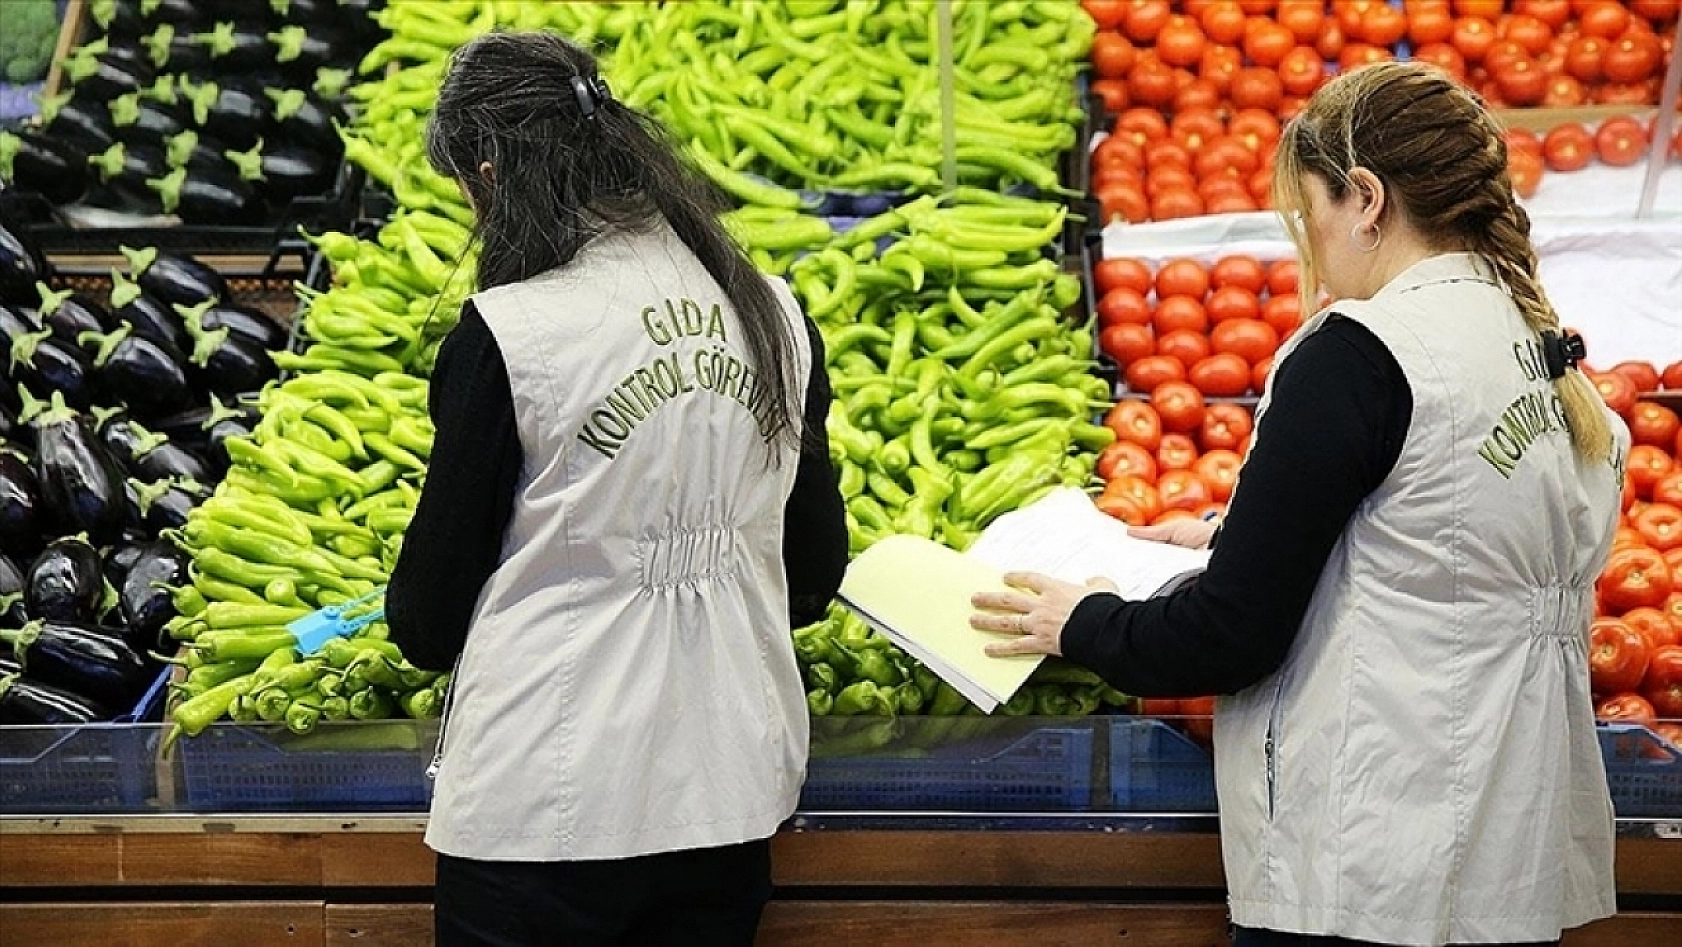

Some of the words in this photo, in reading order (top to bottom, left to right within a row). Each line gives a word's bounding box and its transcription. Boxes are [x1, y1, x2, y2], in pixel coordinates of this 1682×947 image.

[641, 298, 727, 346] GIDA
[577, 351, 695, 460] KONTROL
[1478, 389, 1557, 480] KONTROL
